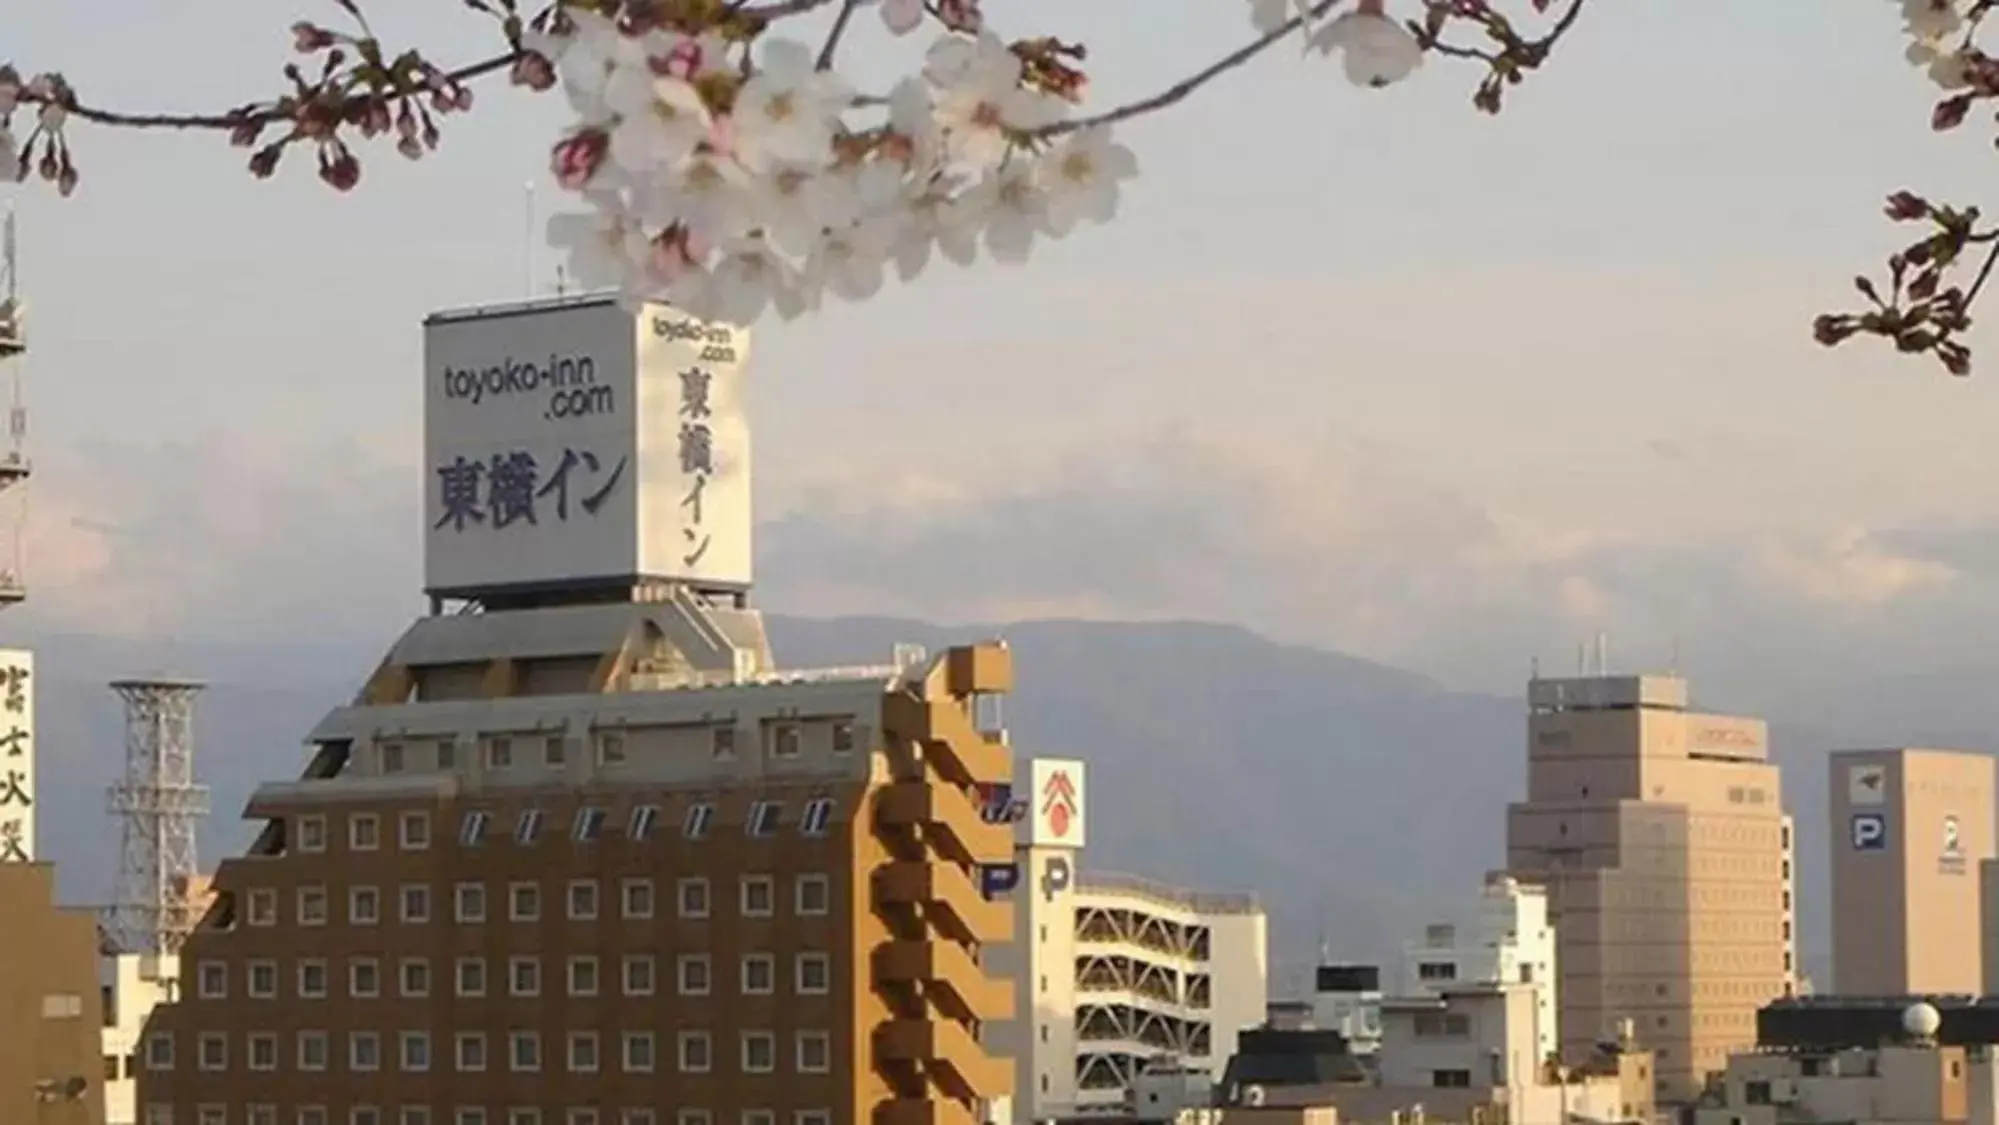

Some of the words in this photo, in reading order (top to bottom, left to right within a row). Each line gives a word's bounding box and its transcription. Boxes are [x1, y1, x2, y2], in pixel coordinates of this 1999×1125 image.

[445, 353, 594, 405] toyoko-inn
[544, 384, 614, 420] .com
[433, 448, 628, 533] 東横イン
[676, 366, 713, 567] 東横イン
[1853, 816, 1882, 847] P
